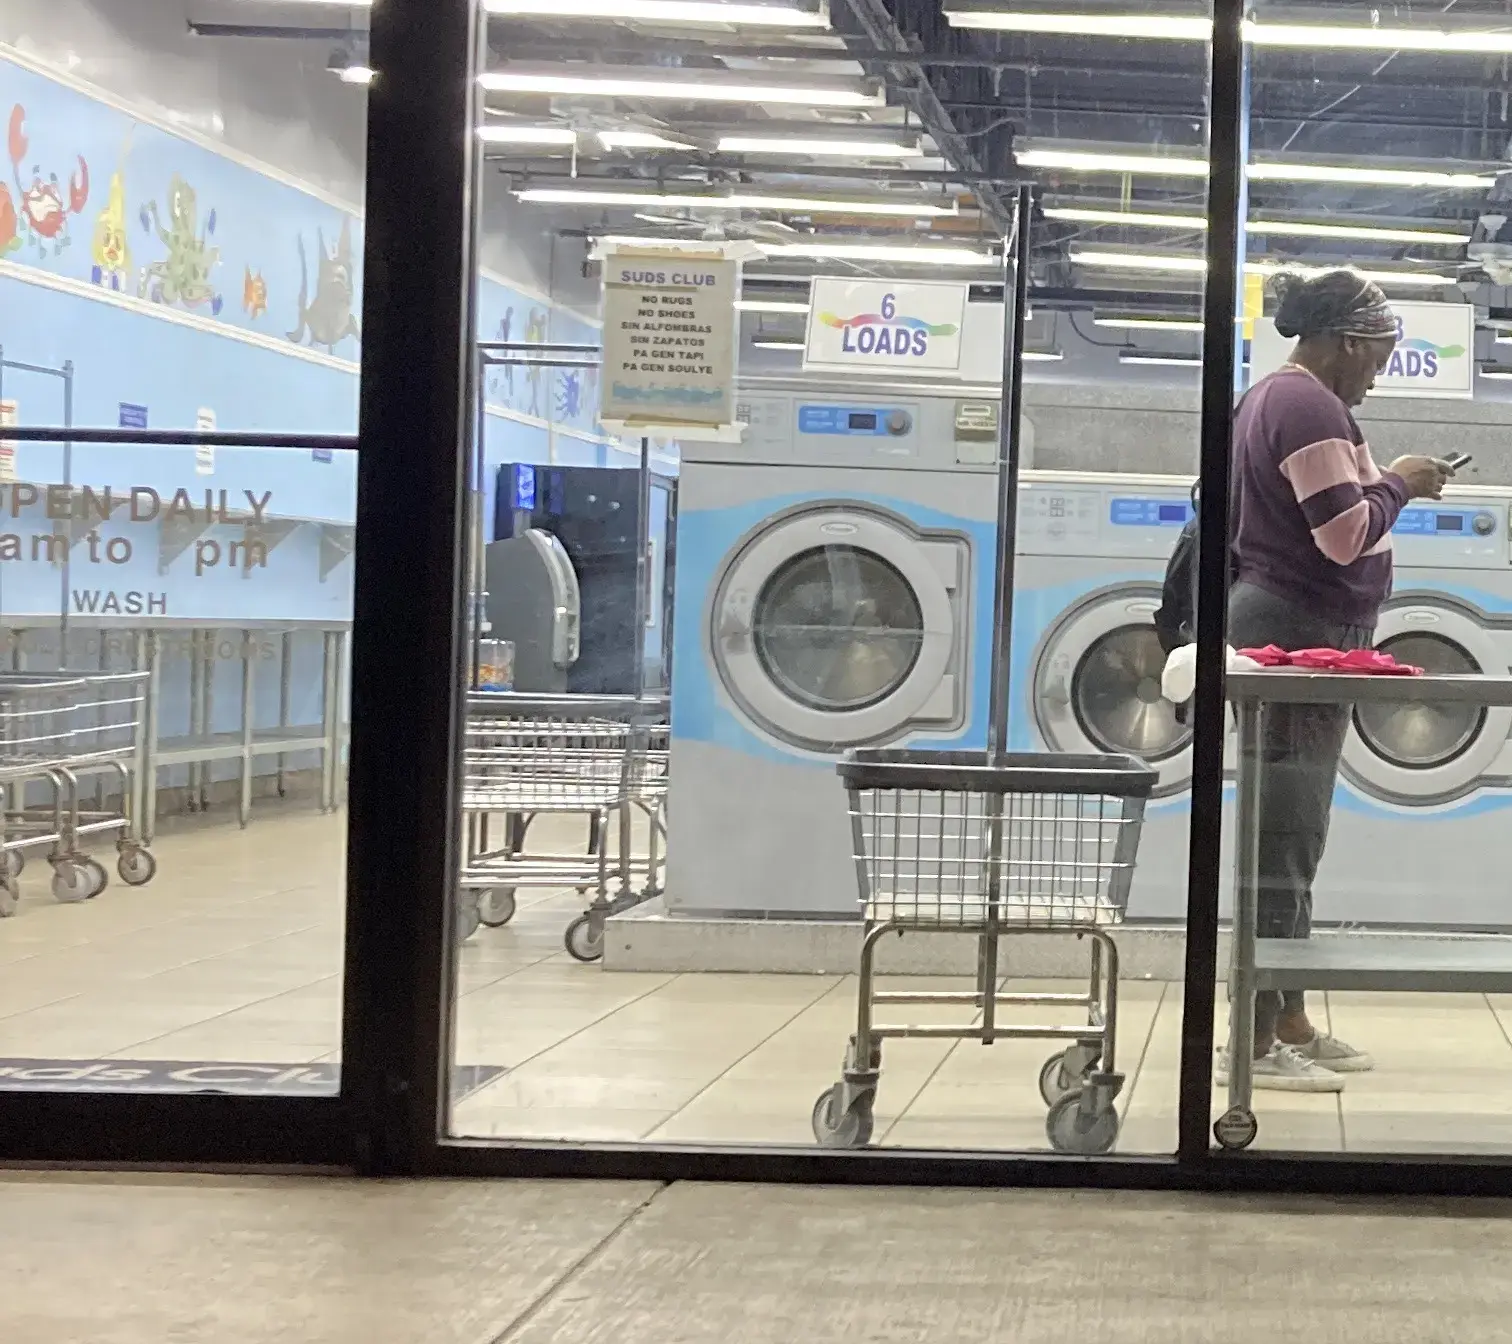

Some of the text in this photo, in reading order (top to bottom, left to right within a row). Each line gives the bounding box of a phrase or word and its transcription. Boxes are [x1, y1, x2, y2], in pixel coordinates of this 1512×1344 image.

[621, 271, 716, 286] SUDS CLUB
[642, 296, 658, 304] NO
[881, 293, 896, 320] 6
[638, 309, 696, 319] NO SHOES
[842, 325, 928, 356] LOADS
[0, 483, 273, 525] PEN DAILY
[87, 529, 132, 564] to
[195, 537, 268, 576] pm
[72, 589, 168, 615] WASH
